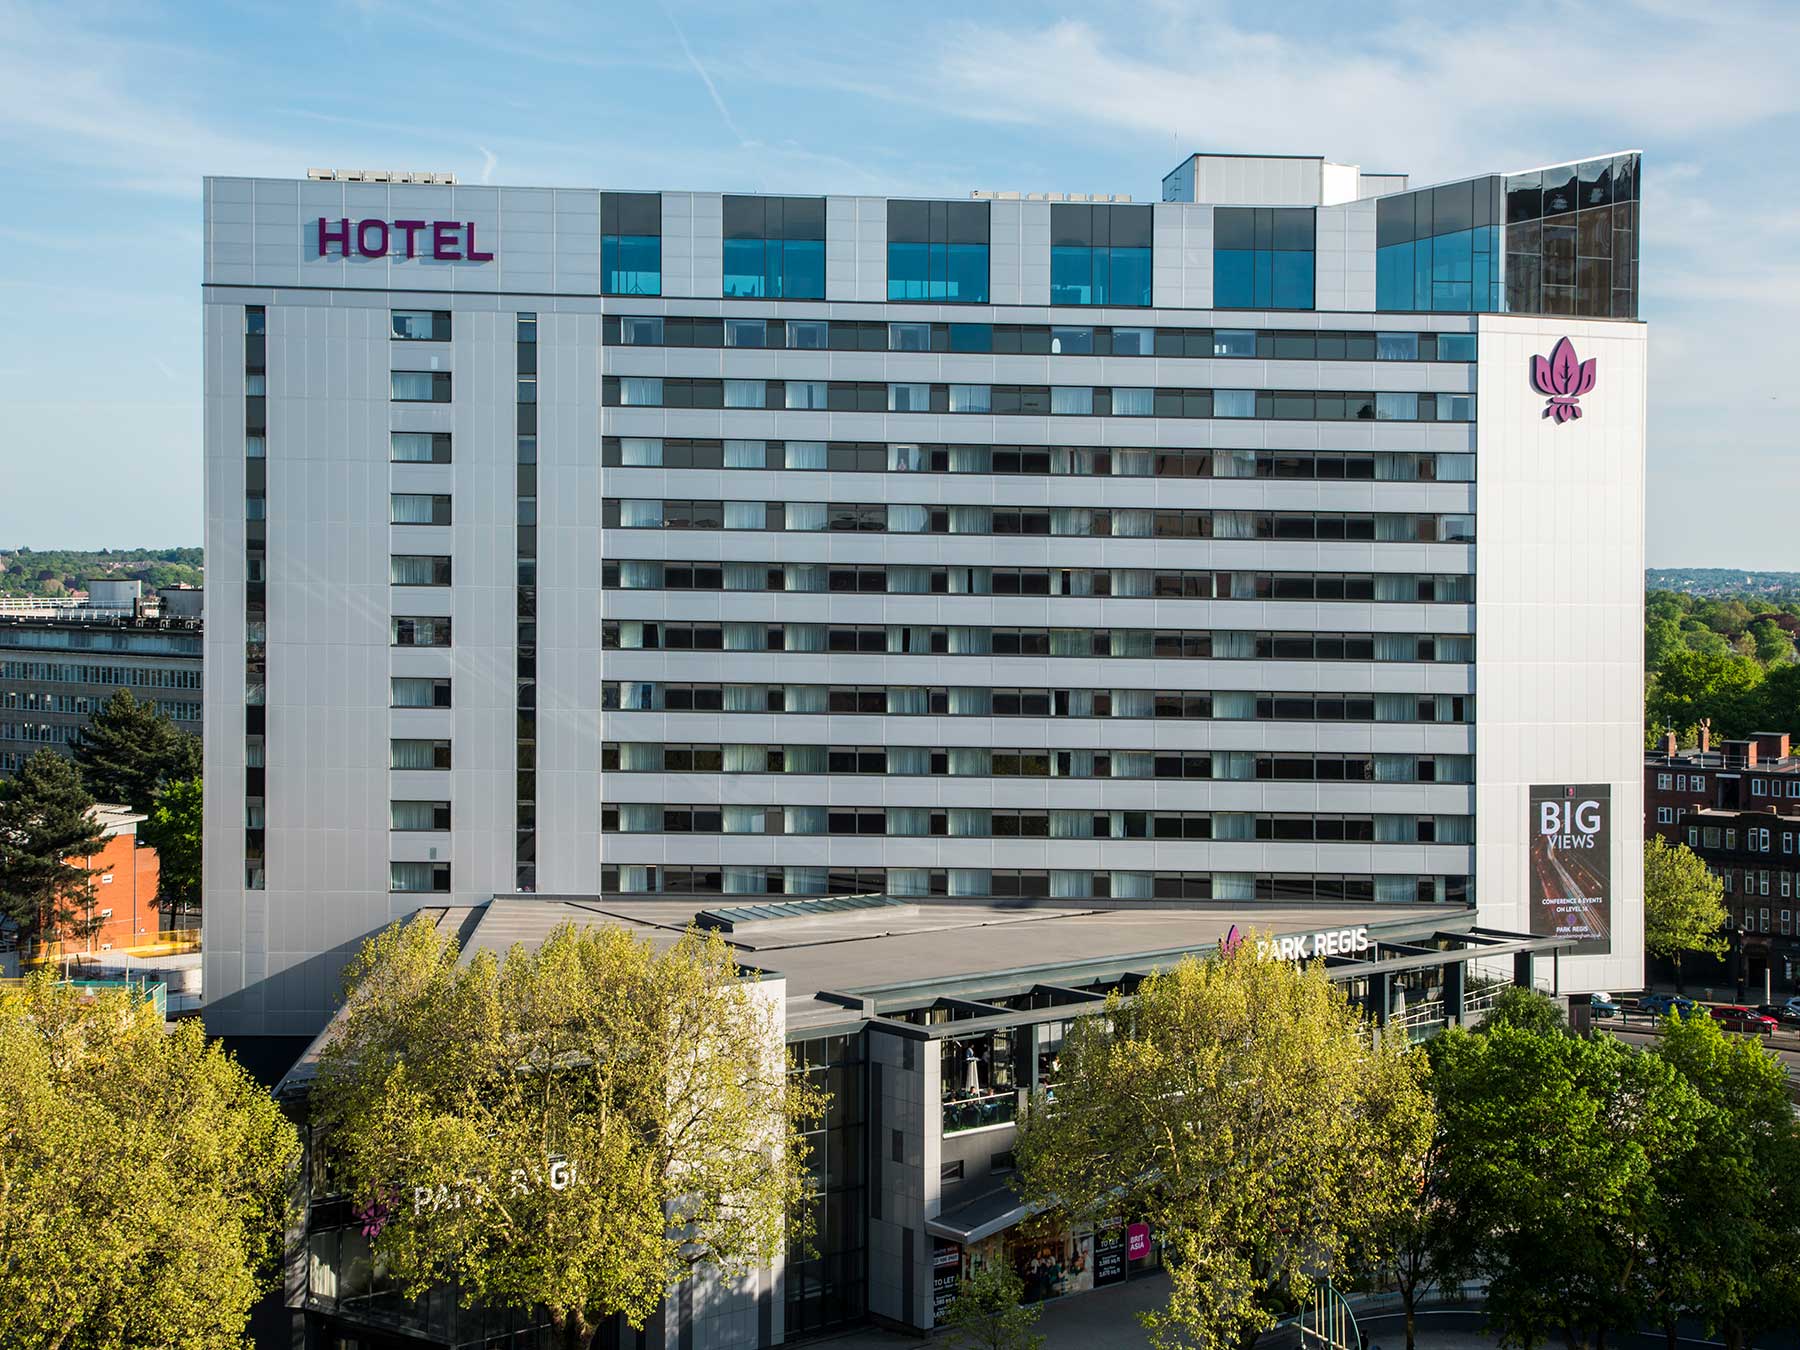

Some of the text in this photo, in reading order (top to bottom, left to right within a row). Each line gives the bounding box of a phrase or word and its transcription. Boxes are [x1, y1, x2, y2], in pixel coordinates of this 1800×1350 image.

[318, 217, 494, 261] HOTEL
[1541, 800, 1601, 835] BIG
[1547, 834, 1595, 849] VIEWS
[1541, 897, 1577, 905] CONFERENCE
[1257, 928, 1368, 962] PARK REGIS
[1130, 1234, 1145, 1244] BRIT
[1130, 1241, 1145, 1251] ASIA
